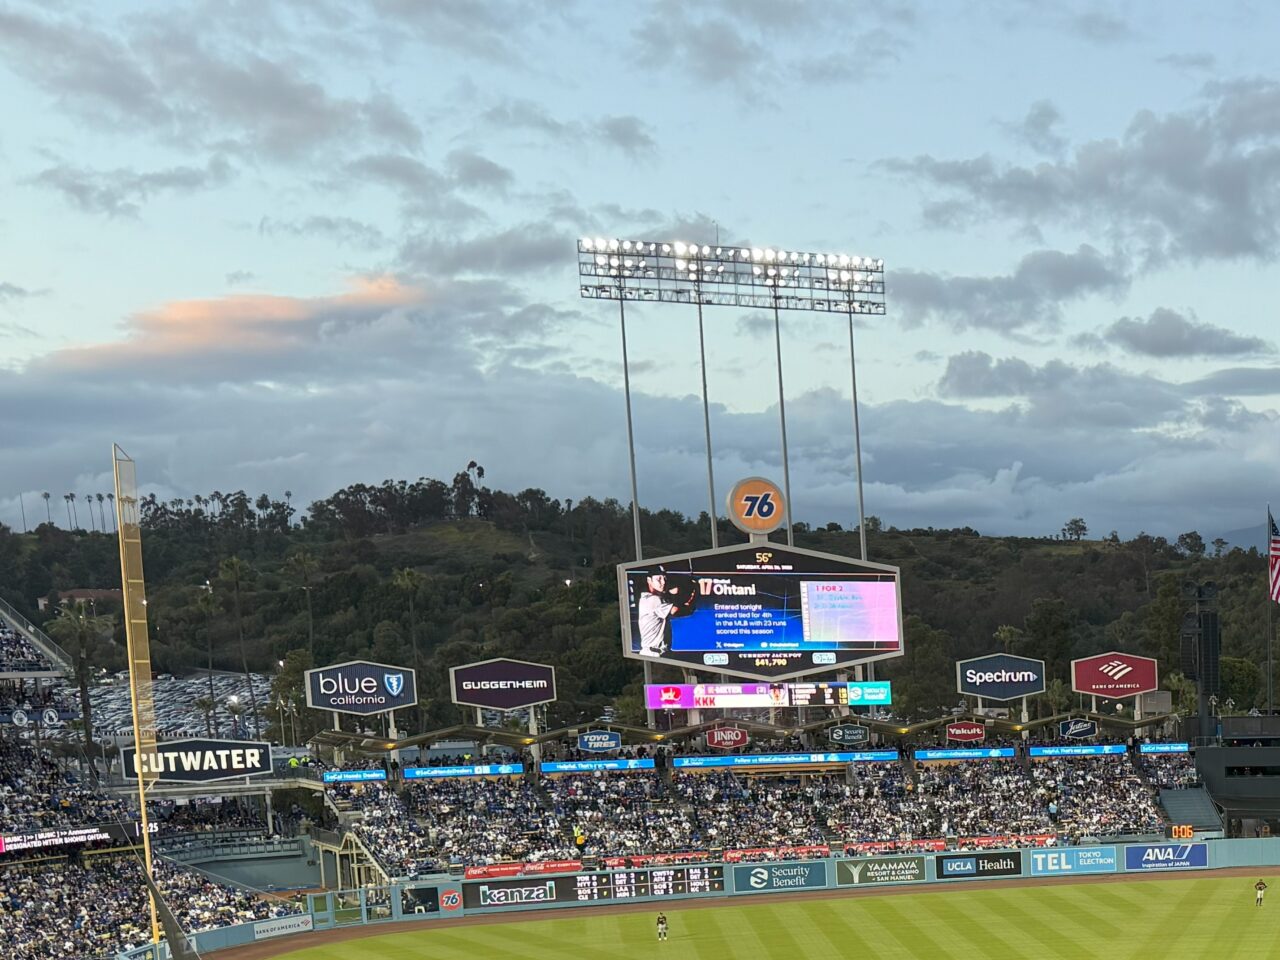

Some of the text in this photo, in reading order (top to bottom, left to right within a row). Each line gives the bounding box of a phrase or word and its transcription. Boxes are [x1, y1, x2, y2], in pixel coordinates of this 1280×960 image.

[741, 492, 776, 518] 76
[698, 578, 712, 595] 17
[713, 584, 756, 595] Ohtani
[319, 672, 377, 694] blue
[966, 669, 1033, 685] Spectrum
[462, 680, 547, 690] GUGGENHEIM
[330, 694, 385, 705] california
[694, 697, 716, 706] KKK
[713, 730, 741, 742] JINRO
[949, 727, 982, 735] Yakult
[583, 734, 609, 742] TOYO
[68, 828, 99, 836] Announcer:
[1171, 825, 1193, 838] 0:06
[6, 840, 42, 850] DESIGNATED
[43, 838, 64, 847] HITTER
[65, 836, 86, 844] SHOHEI
[1142, 848, 1174, 860] ANA
[947, 858, 1014, 871] UCLA Health
[1033, 853, 1072, 871] TEL
[772, 866, 809, 879] Security
[773, 876, 805, 887] Benefit
[443, 894, 458, 906] 76
[277, 923, 300, 931] AMERICA
